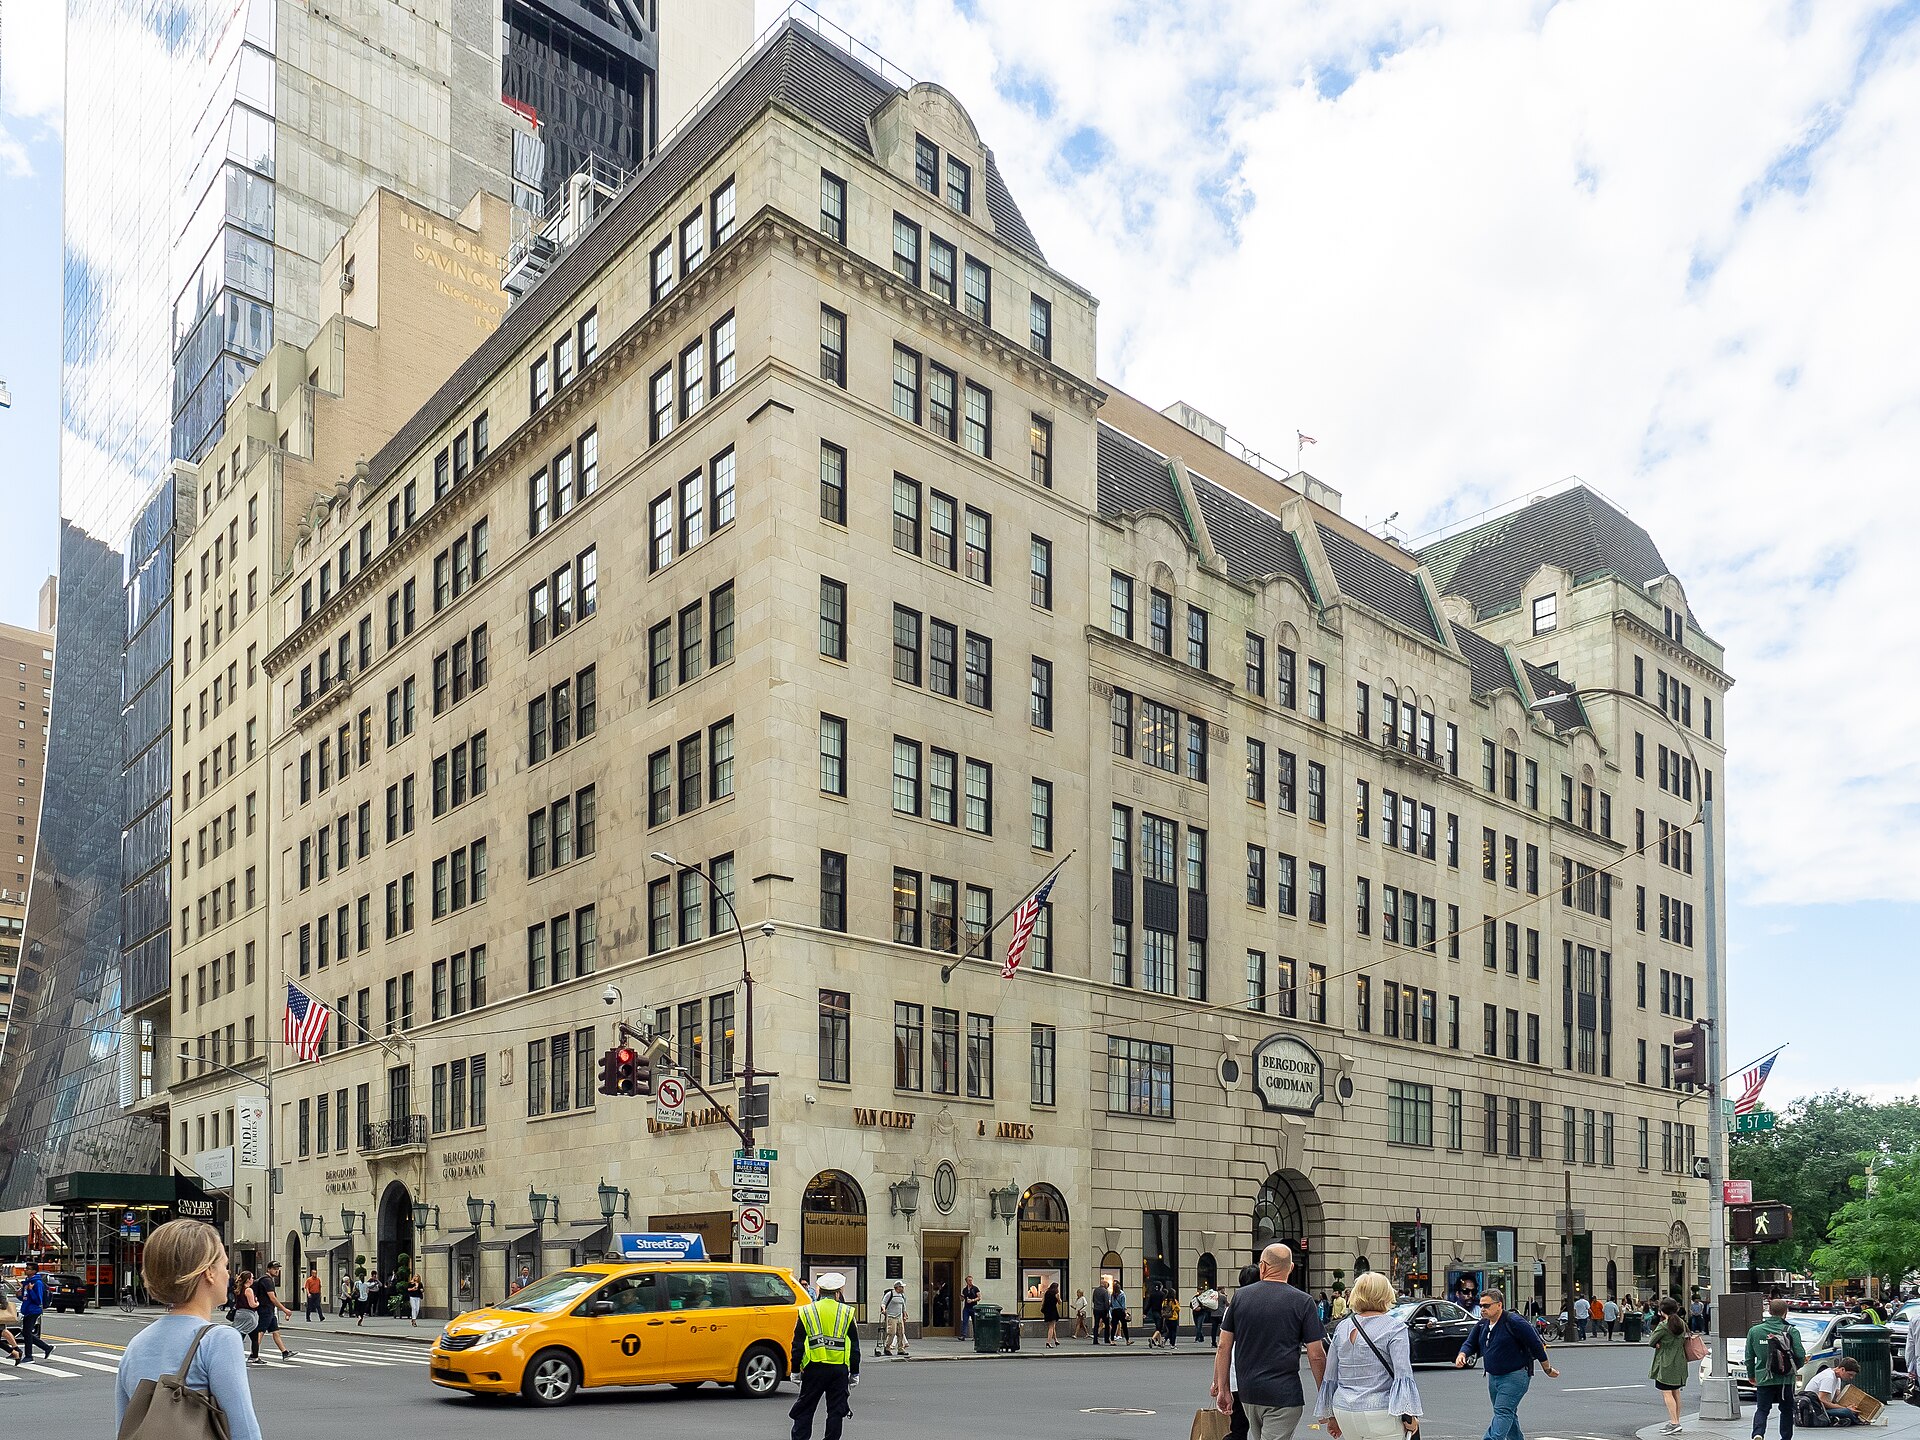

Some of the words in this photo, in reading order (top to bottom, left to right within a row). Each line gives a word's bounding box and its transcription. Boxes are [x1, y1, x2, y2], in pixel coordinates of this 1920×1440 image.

[401, 211, 441, 243] THE
[453, 237, 504, 271] GREE
[415, 244, 495, 292] SAVINGS
[1262, 1055, 1317, 1075] BERGDORF
[1265, 1075, 1313, 1093] GOODMAN
[853, 1107, 877, 1127] VAN
[879, 1110, 916, 1130] CLEEF
[976, 1119, 986, 1137] &
[996, 1121, 1034, 1140] ARPELS
[1736, 1116, 1742, 1130] E
[1747, 1114, 1760, 1129] 57
[1764, 1113, 1772, 1123] St
[240, 1105, 251, 1164] FINDLAY
[442, 1147, 485, 1163] BERGDORF
[763, 1150, 768, 1159] 5
[325, 1166, 358, 1181] BERGDORF
[442, 1164, 485, 1179] GOODMAN
[325, 1180, 358, 1195] GOODMAN
[736, 1191, 749, 1199] ONE
[178, 1206, 213, 1216] GALLERY
[636, 1239, 691, 1252] StreetEasy
[887, 1242, 900, 1250] 744
[988, 1244, 1000, 1252] 744
[624, 1337, 639, 1354] T
